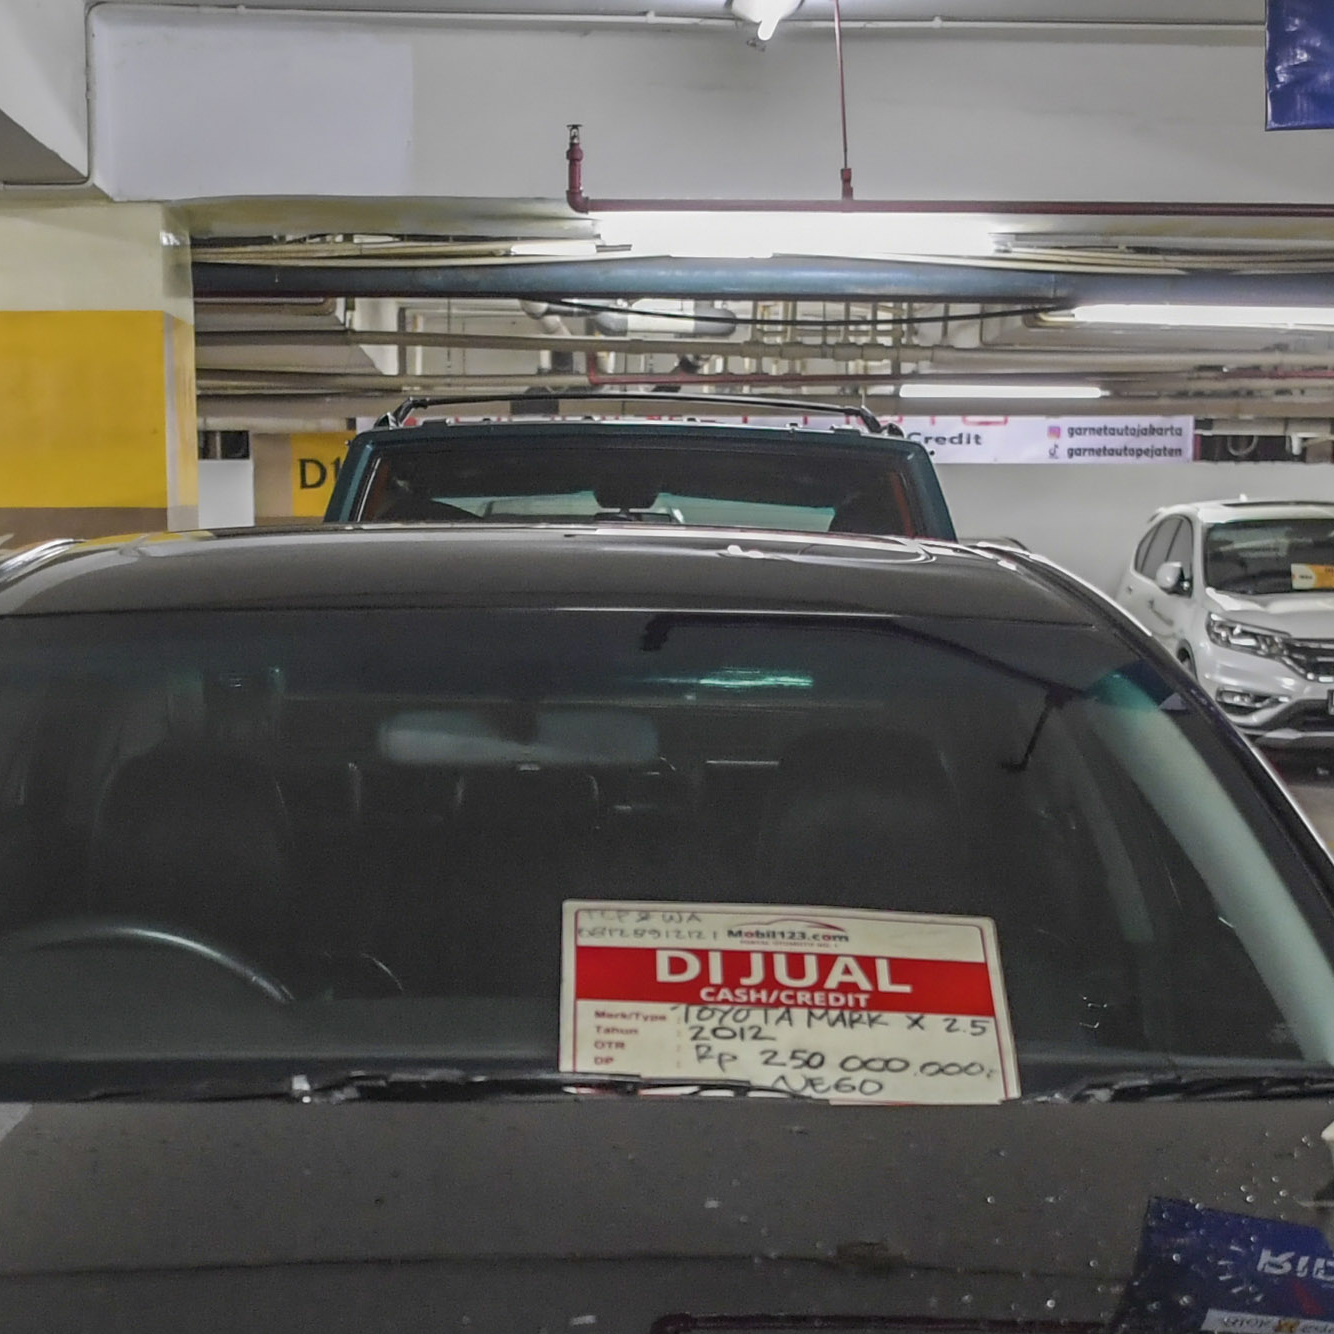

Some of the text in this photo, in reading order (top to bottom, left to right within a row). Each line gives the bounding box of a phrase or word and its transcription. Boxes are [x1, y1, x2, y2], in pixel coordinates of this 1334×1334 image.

[907, 432, 983, 446] Credit
[1067, 425, 1183, 438] garnetautojakarta
[1067, 446, 1183, 459] garnetautopejaten
[727, 928, 850, 943] Mobil123.com
[655, 949, 912, 994] DI JUAL
[699, 986, 871, 1009] CASH/CREDIT
[670, 1005, 990, 1037] TOYOTA MARK X 2.5
[596, 1025, 639, 1035] Tahun
[688, 1025, 777, 1042] 2012
[594, 1041, 626, 1050] OTR
[594, 1056, 615, 1066] DP
[695, 1044, 738, 1073] Rp
[759, 1049, 825, 1070] 250
[771, 1075, 883, 1096] NEGO
